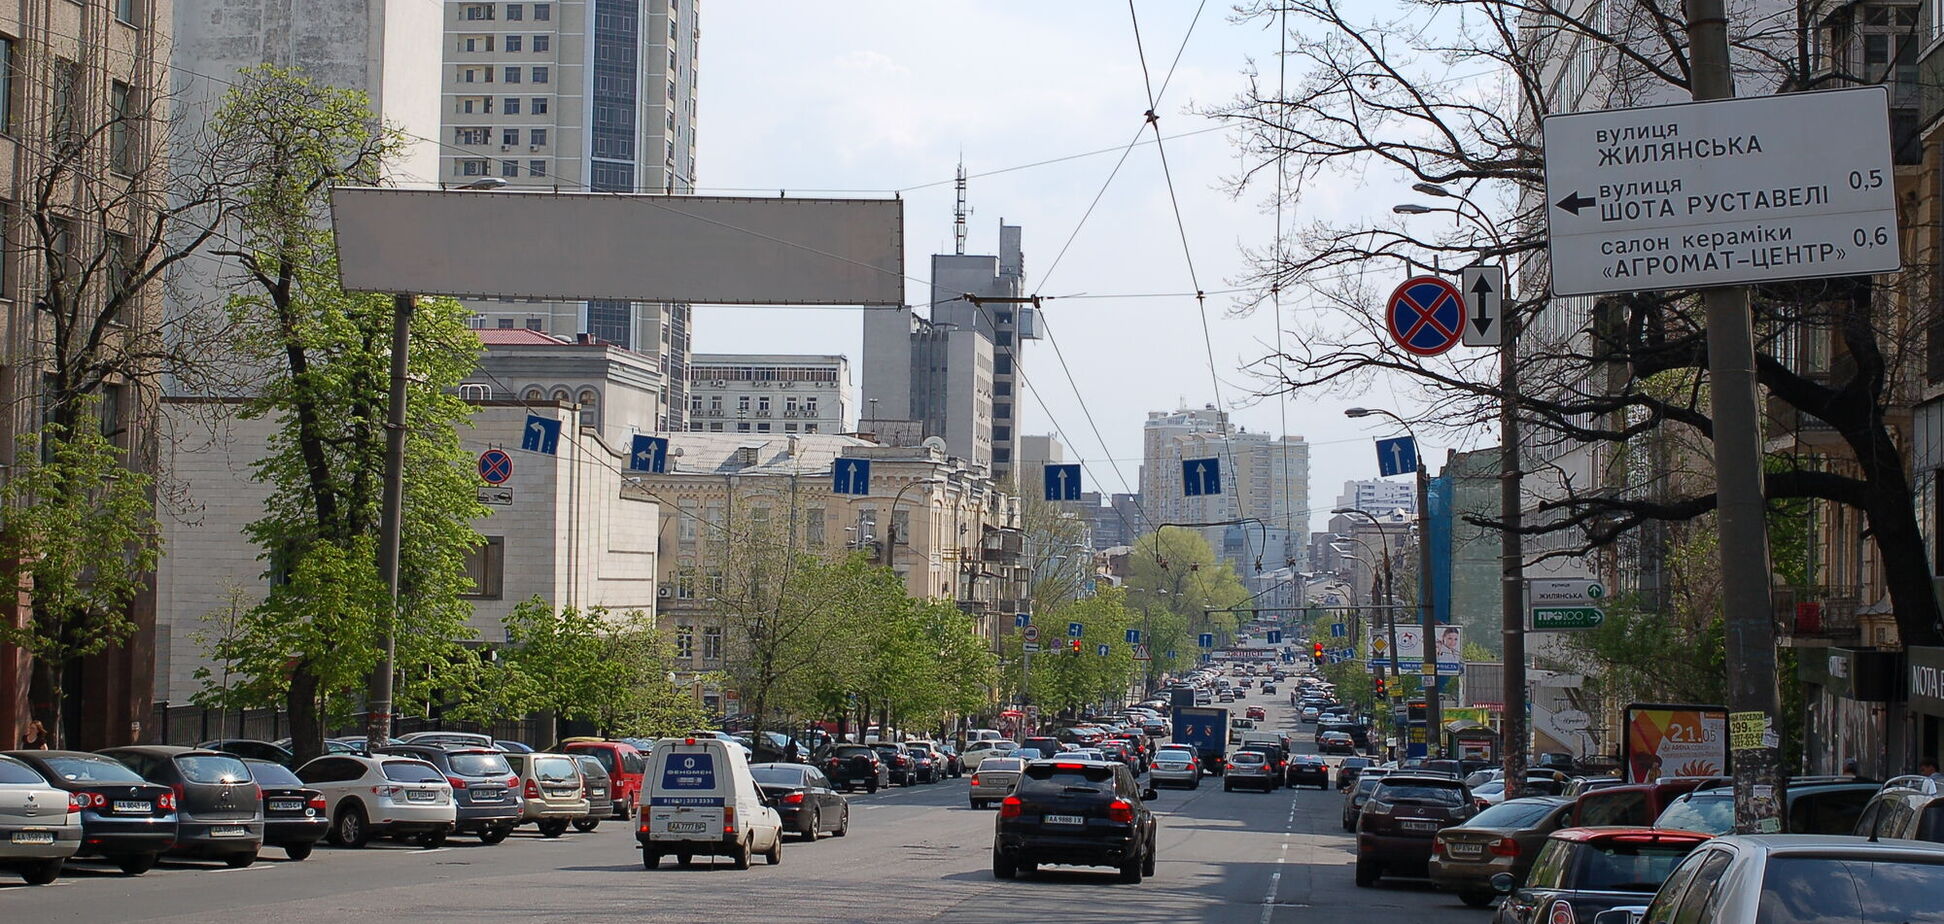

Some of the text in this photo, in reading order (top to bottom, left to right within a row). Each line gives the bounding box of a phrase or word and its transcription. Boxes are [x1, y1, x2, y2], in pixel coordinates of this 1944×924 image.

[1596, 122, 1679, 144] вулиця
[1598, 135, 1762, 167] ЖИЛЯНСЬКА
[1599, 176, 1683, 198] вулиця
[1848, 169, 1884, 193] 0,5
[1600, 184, 1829, 222] ШОТА РУСТАВЕЛІ
[1601, 224, 1793, 256] салон кераміки
[1852, 227, 1888, 251] 0,6
[1911, 664, 1939, 698] NOTA
[1669, 722, 1717, 743] 21.05
